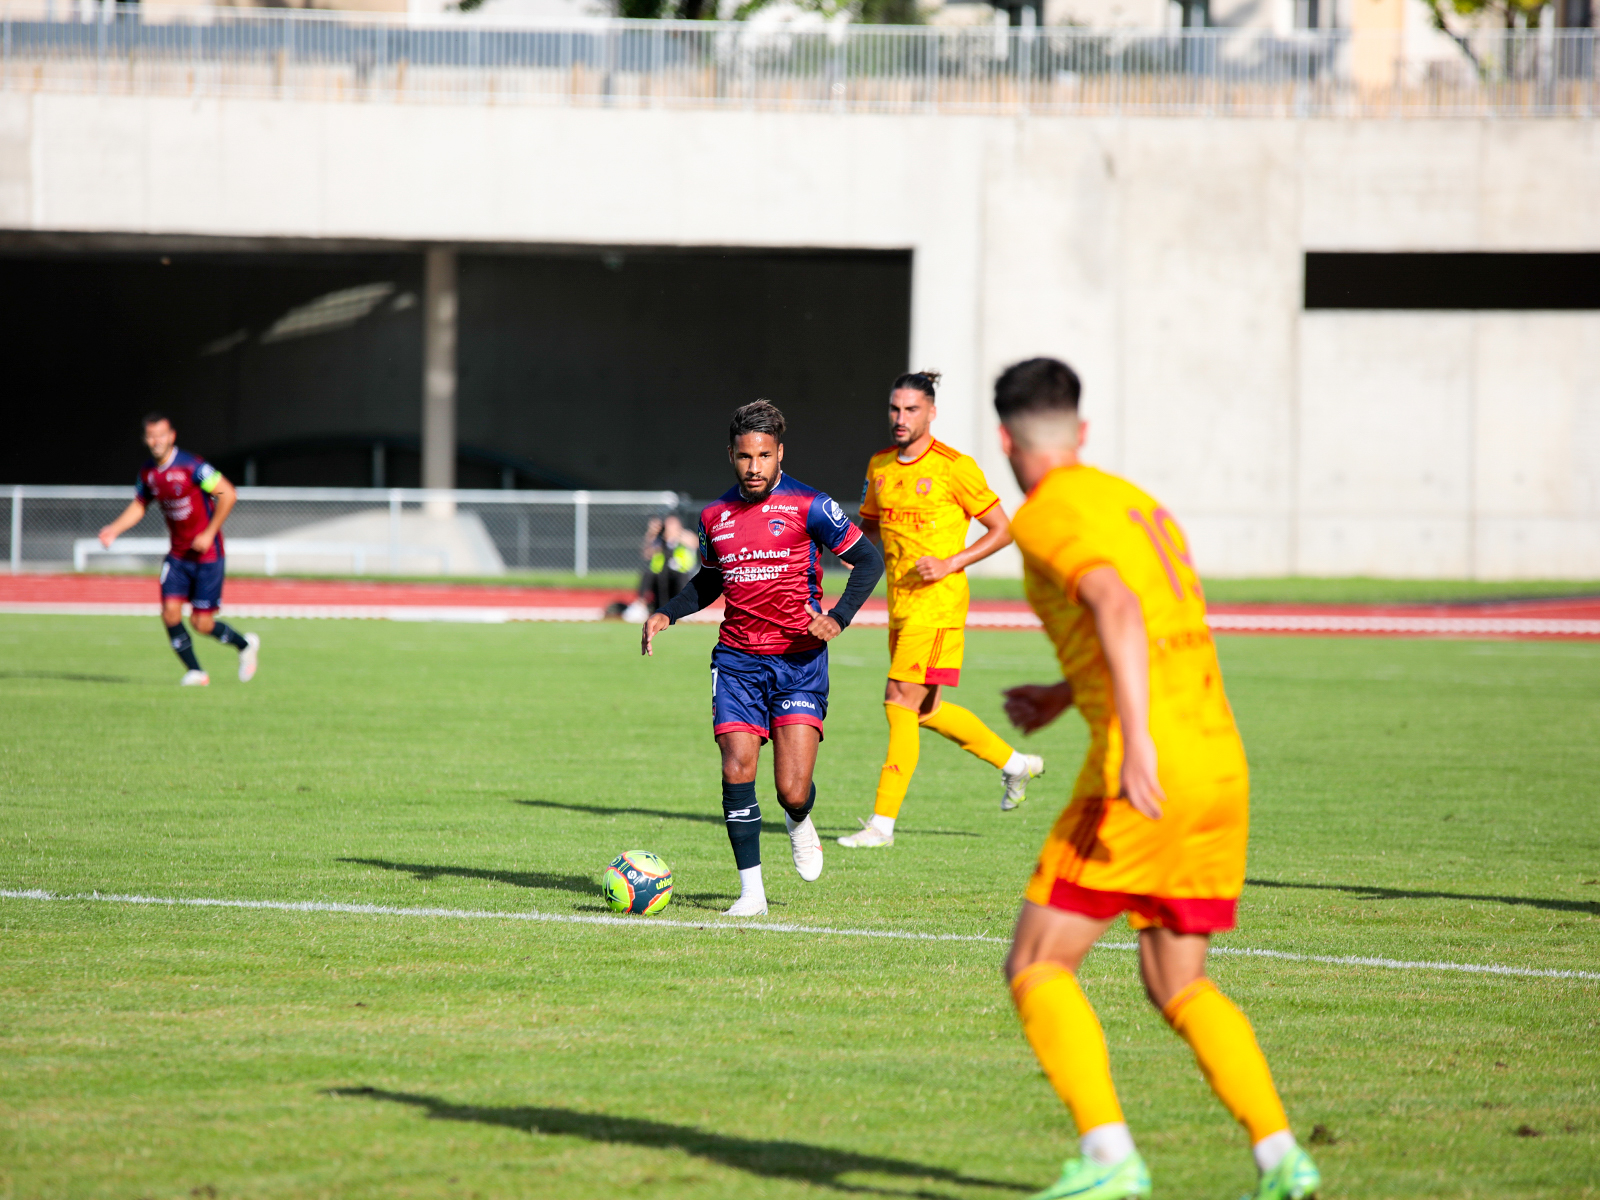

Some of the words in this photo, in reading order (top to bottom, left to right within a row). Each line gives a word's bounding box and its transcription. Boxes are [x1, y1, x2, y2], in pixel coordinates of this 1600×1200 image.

[718, 553, 738, 564] rédit
[752, 548, 791, 560] Mutuel
[733, 564, 789, 575] CLERMONT
[790, 700, 816, 710] VEOLIA
